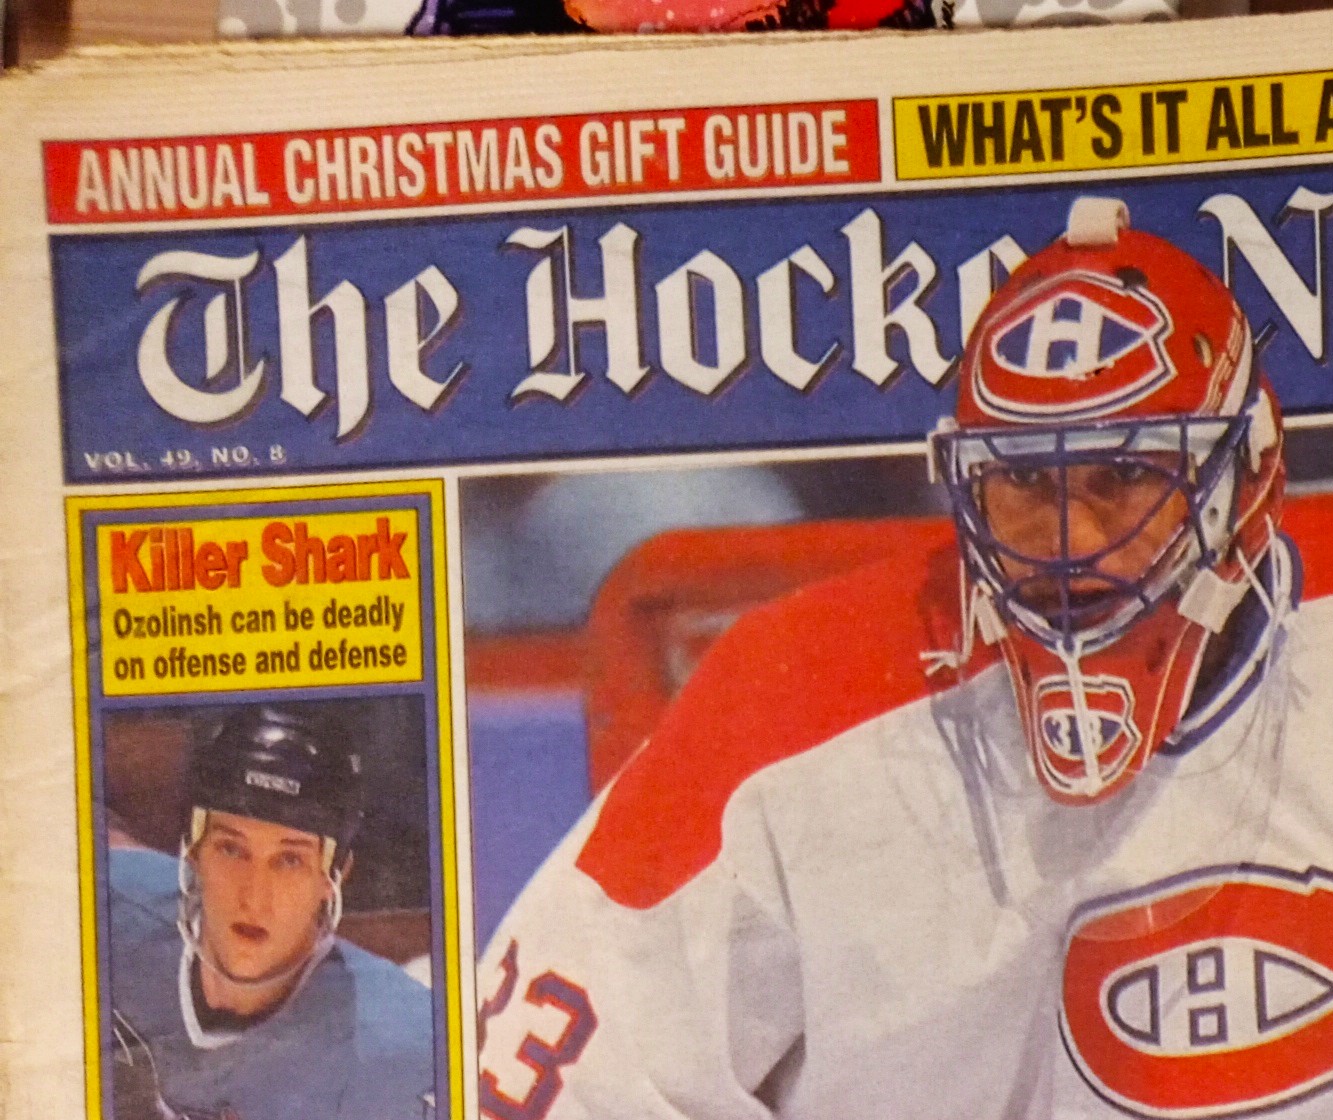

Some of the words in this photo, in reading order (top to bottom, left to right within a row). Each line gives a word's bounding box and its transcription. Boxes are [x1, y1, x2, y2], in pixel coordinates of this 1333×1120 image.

[76, 142, 270, 214] ANNUAL
[284, 125, 565, 204] CHRISTMAS
[580, 115, 688, 186] GIFT
[704, 108, 851, 178] GUIDE
[919, 94, 1122, 168] WHAT'S
[1141, 90, 1191, 156] IT
[1206, 82, 1299, 152] ALL
[136, 235, 470, 443] The
[83, 450, 151, 472] VOL.
[211, 446, 261, 467] NO.
[269, 444, 288, 465] 8
[109, 522, 250, 595] Killer
[261, 517, 412, 589] Shark
[113, 604, 222, 640] Ozolinsh
[231, 603, 276, 632] can
[284, 600, 314, 632] be
[322, 595, 405, 634] deadly
[113, 655, 145, 681] on
[153, 648, 247, 680] offense
[255, 642, 301, 674] and
[308, 638, 408, 673] defense
